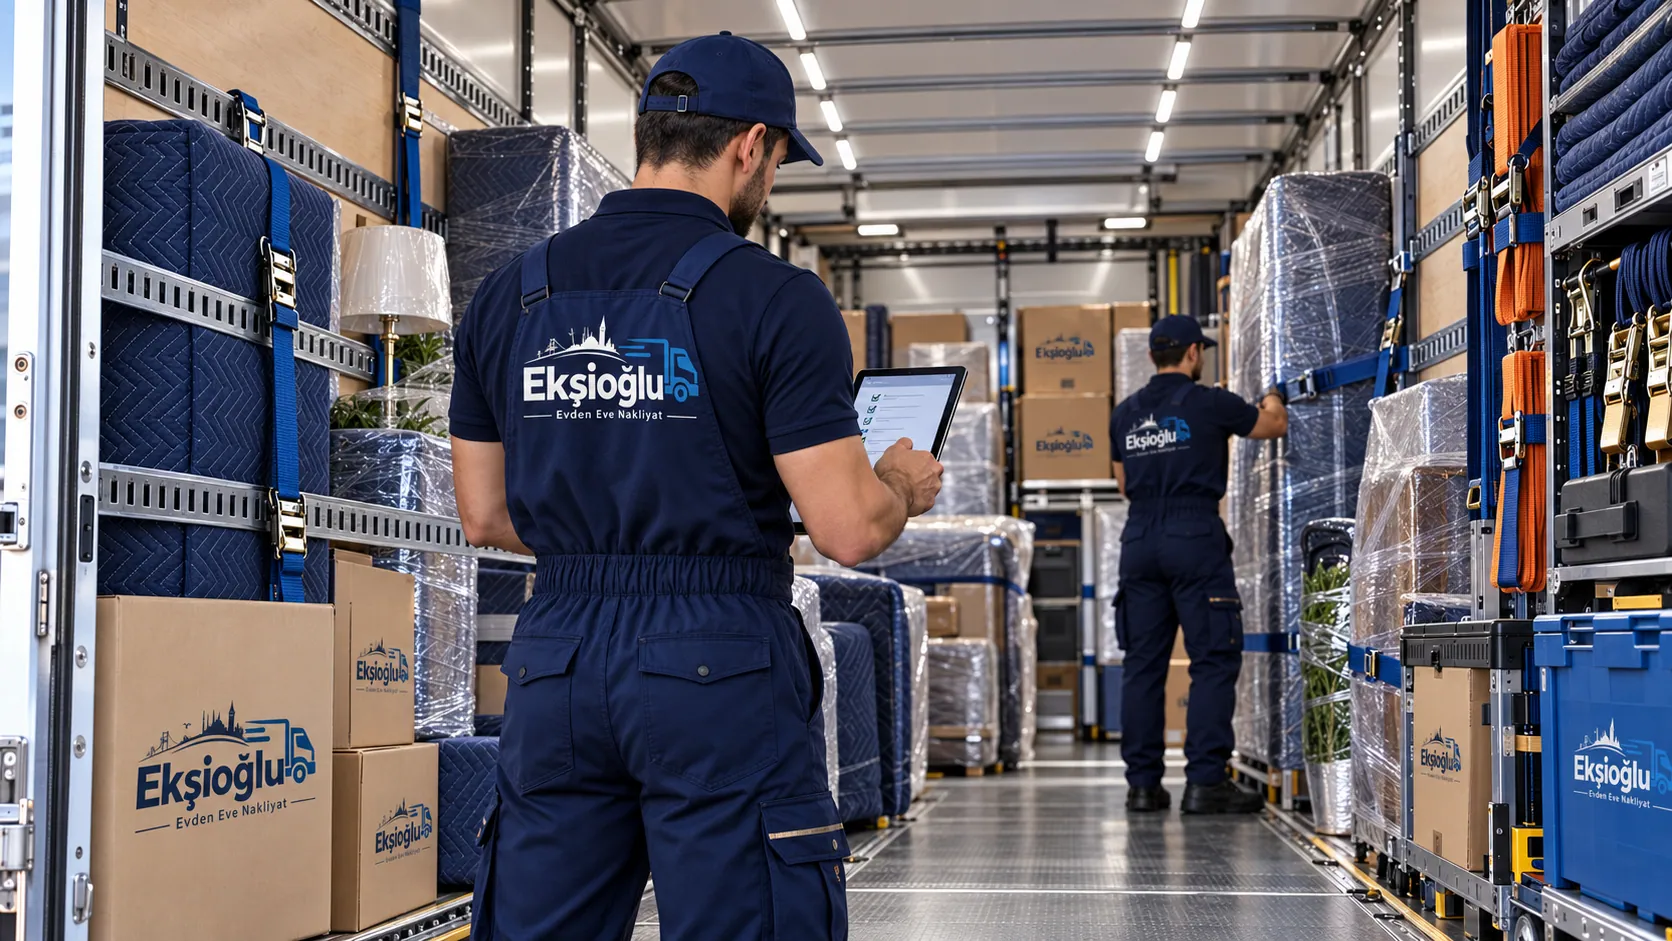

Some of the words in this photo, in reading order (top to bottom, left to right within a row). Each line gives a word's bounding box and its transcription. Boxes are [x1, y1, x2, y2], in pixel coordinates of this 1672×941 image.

[523, 362, 664, 408] Ekşioğlu
[556, 410, 592, 420] Evden
[596, 410, 614, 420] Eve
[618, 409, 663, 422] Nakliyat
[1125, 428, 1177, 451] Ekşioğlu
[356, 660, 399, 687] Ekşioğlu
[136, 750, 285, 812] Ekşioğlu
[1574, 754, 1651, 794] Ekşioğlu
[1588, 789, 1607, 800] Evden
[1608, 792, 1620, 803] Eve
[176, 813, 214, 830] Evden
[218, 808, 239, 822] Eve
[242, 798, 288, 816] Nakliyat
[375, 821, 421, 854] Ekşioğlu
